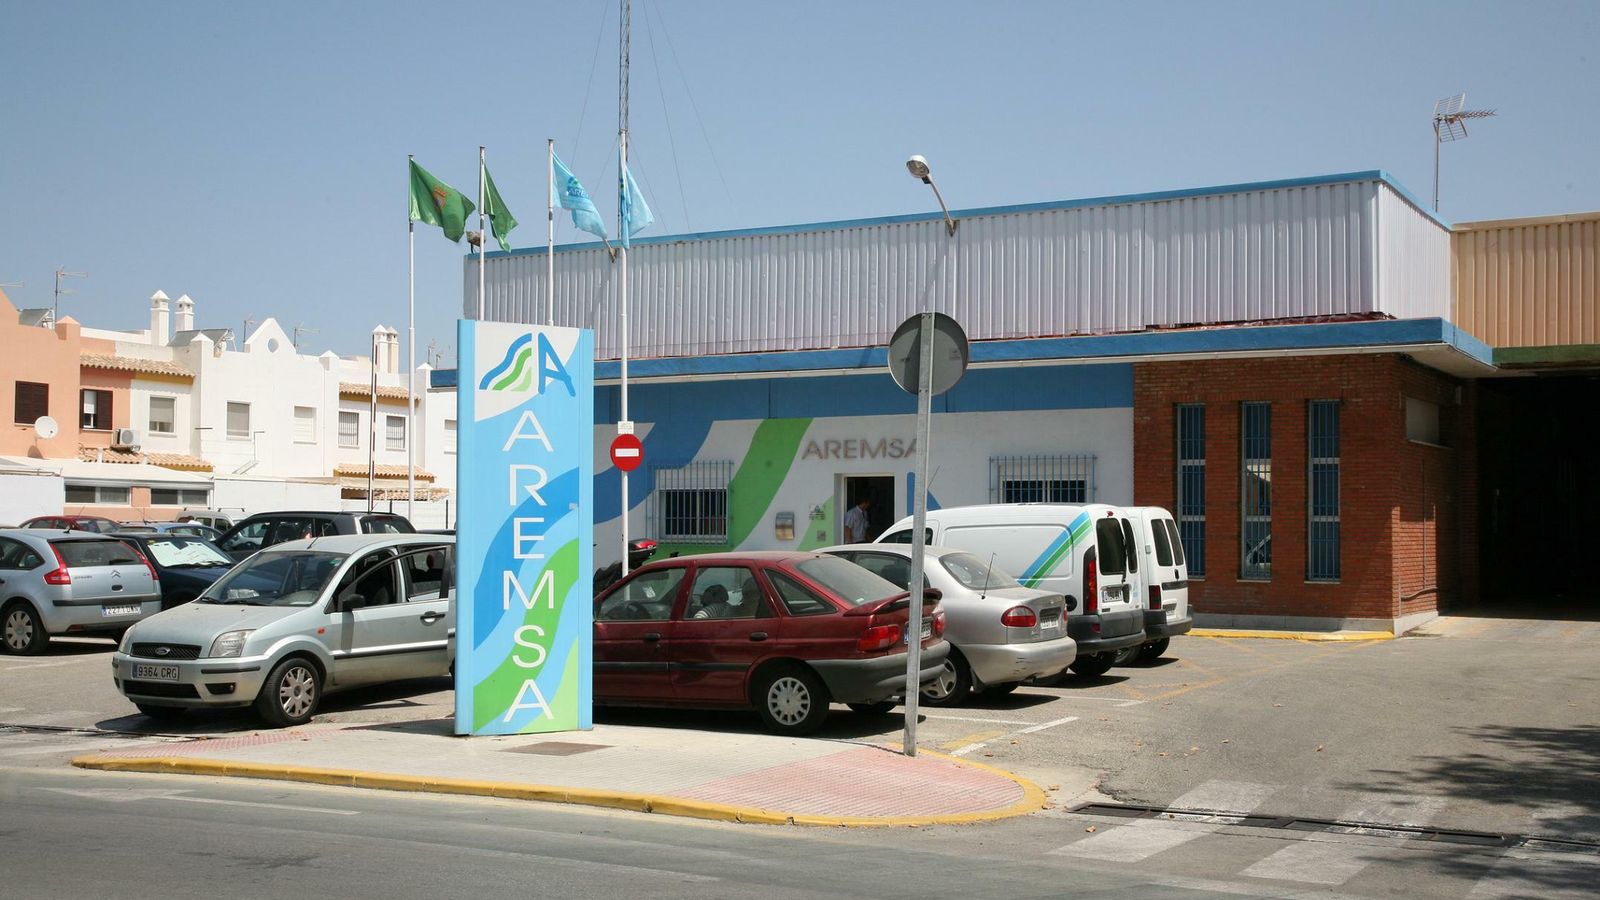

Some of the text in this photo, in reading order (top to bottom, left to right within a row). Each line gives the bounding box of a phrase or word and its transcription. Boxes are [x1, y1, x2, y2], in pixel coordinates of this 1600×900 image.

[502, 409, 555, 723] AREMSA
[138, 666, 177, 679] 9364 CRG
